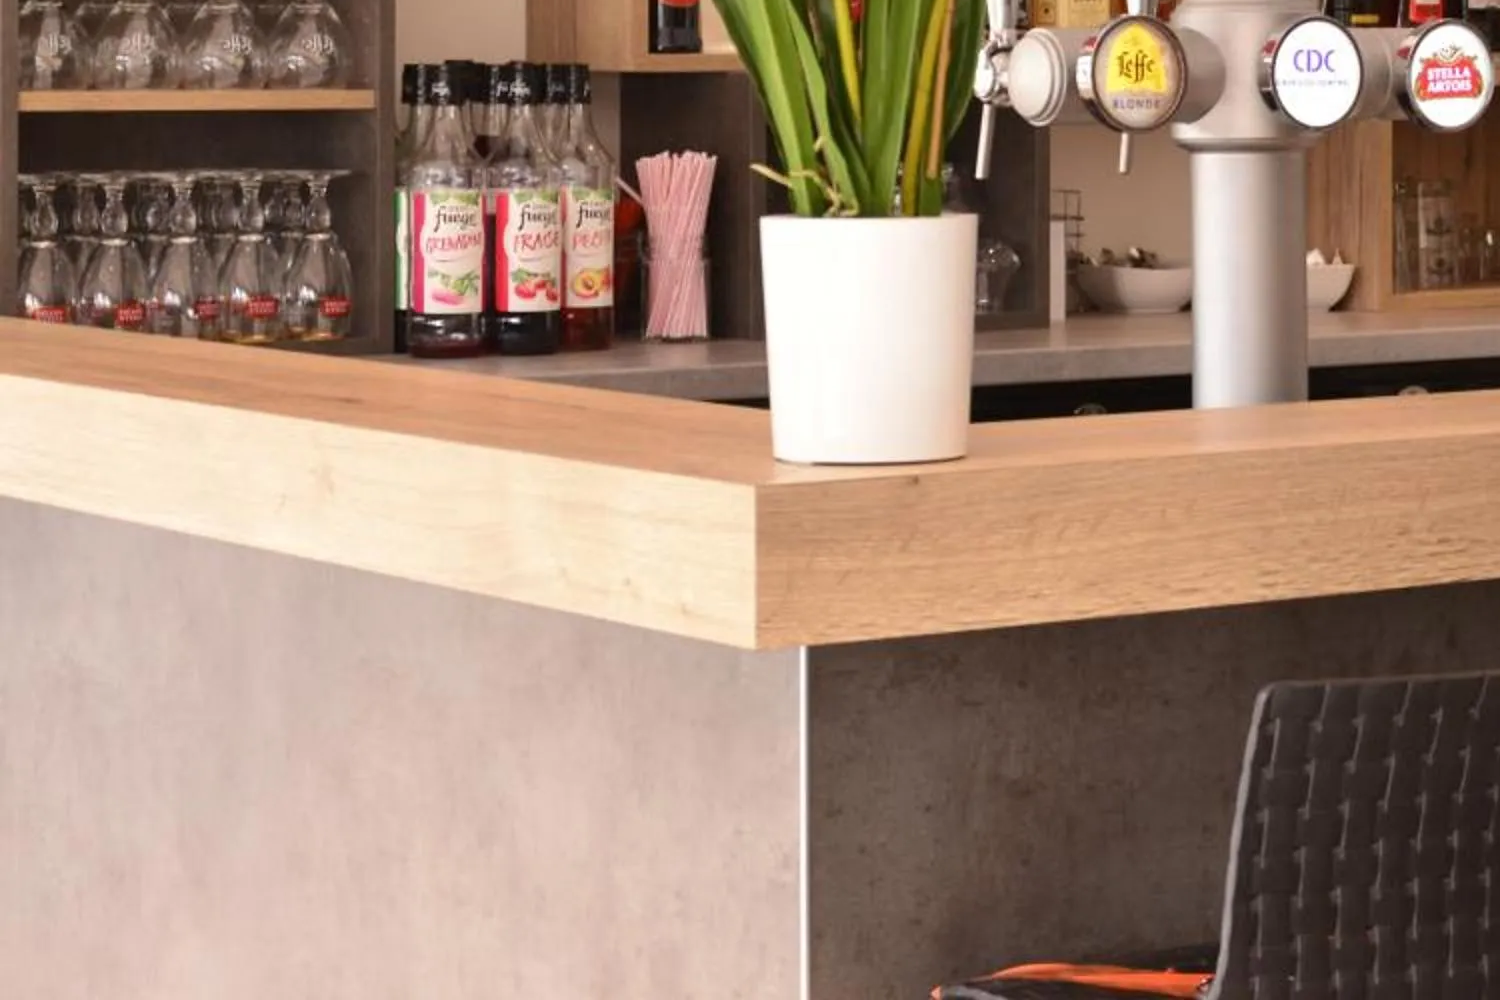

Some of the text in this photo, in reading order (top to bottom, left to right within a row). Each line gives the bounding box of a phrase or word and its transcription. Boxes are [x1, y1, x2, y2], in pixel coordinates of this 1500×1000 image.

[1117, 49, 1155, 83] Leffe
[1293, 49, 1336, 73] CDC
[1427, 66, 1471, 80] STELLA
[1427, 79, 1472, 93] ARTOIS
